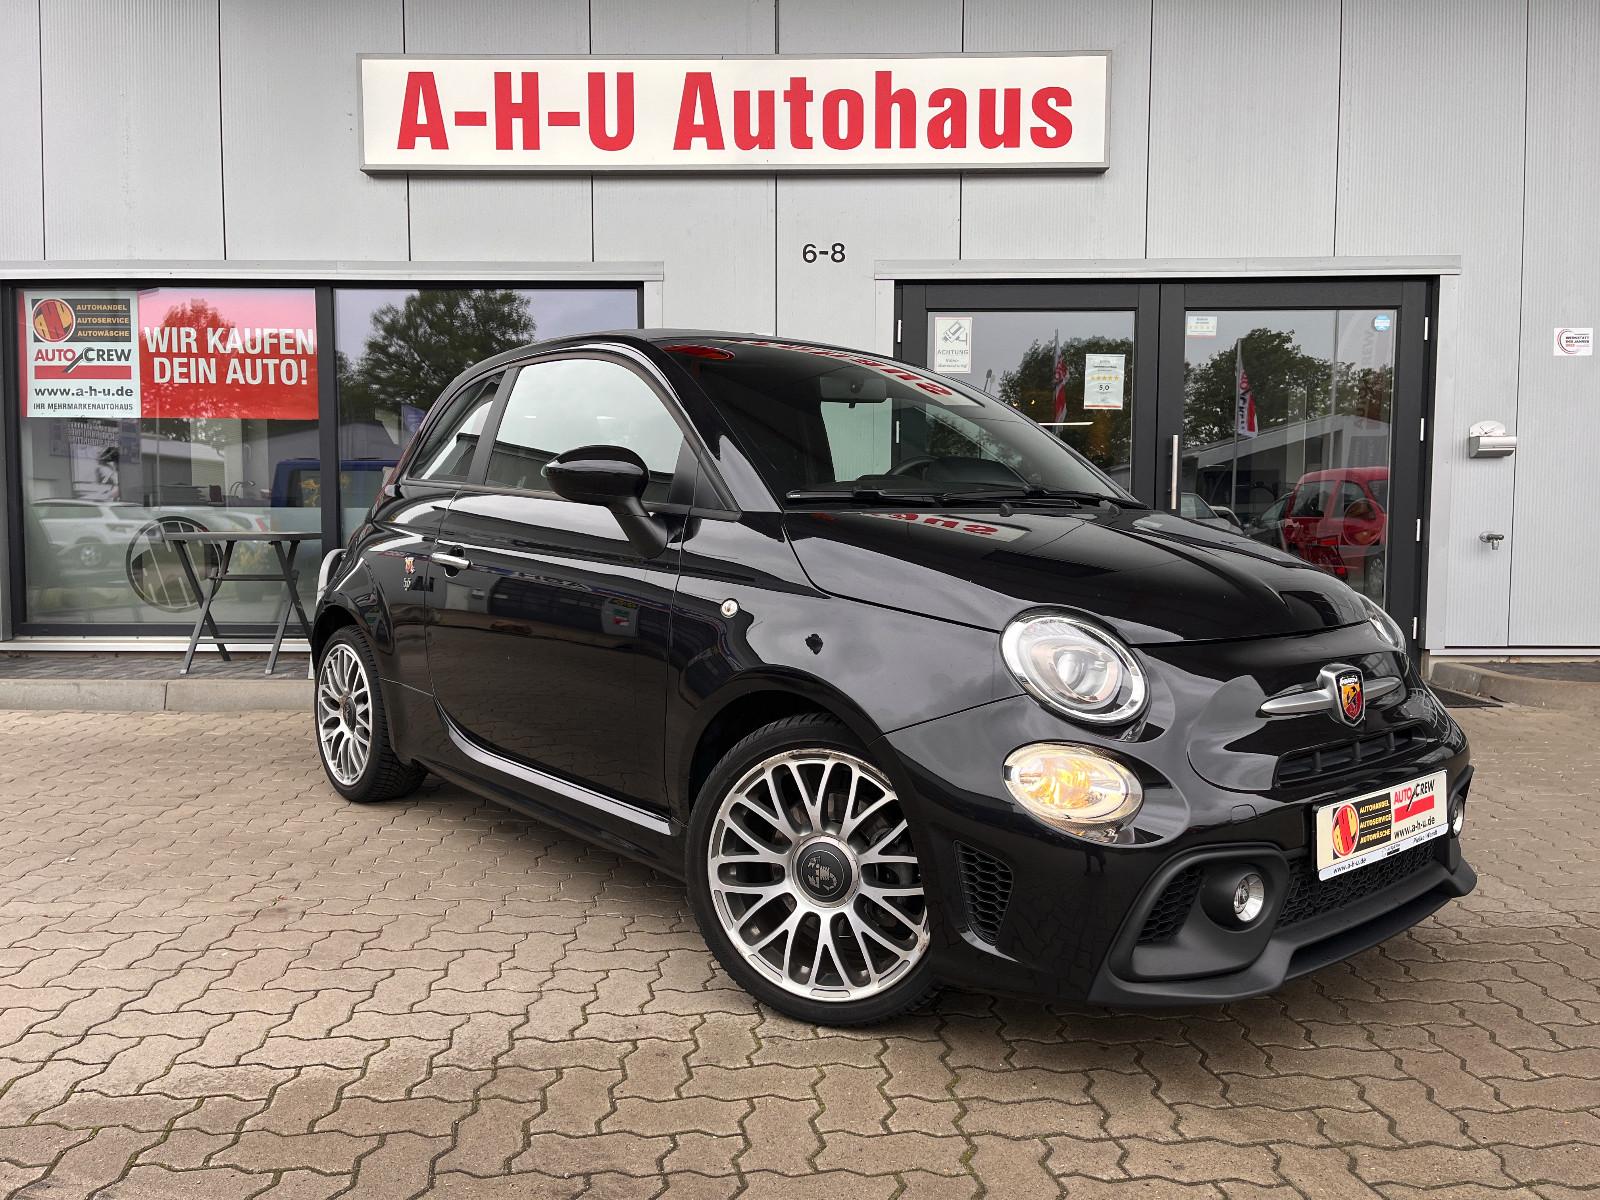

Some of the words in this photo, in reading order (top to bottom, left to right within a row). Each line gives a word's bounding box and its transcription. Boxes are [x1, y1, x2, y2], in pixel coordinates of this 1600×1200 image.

[397, 71, 635, 151] A-H-U
[673, 70, 1073, 151] Autohaus
[802, 242, 846, 263] 6-8
[77, 329, 130, 337] AUTOWÄSCHE
[144, 326, 198, 353] WIR
[207, 327, 315, 354] KAUFEN
[153, 357, 216, 384] DEIN
[226, 358, 308, 385] AUTO!
[34, 385, 134, 397] www.a-h-u.de
[33, 403, 45, 411] IHR
[47, 403, 133, 411] MEHRMARKENAUTOHAUS
[1359, 799, 1391, 814] AUTOHANDEL
[1359, 814, 1392, 829] AUTOSERVICE
[1393, 815, 1436, 839] www.a-h-u.de
